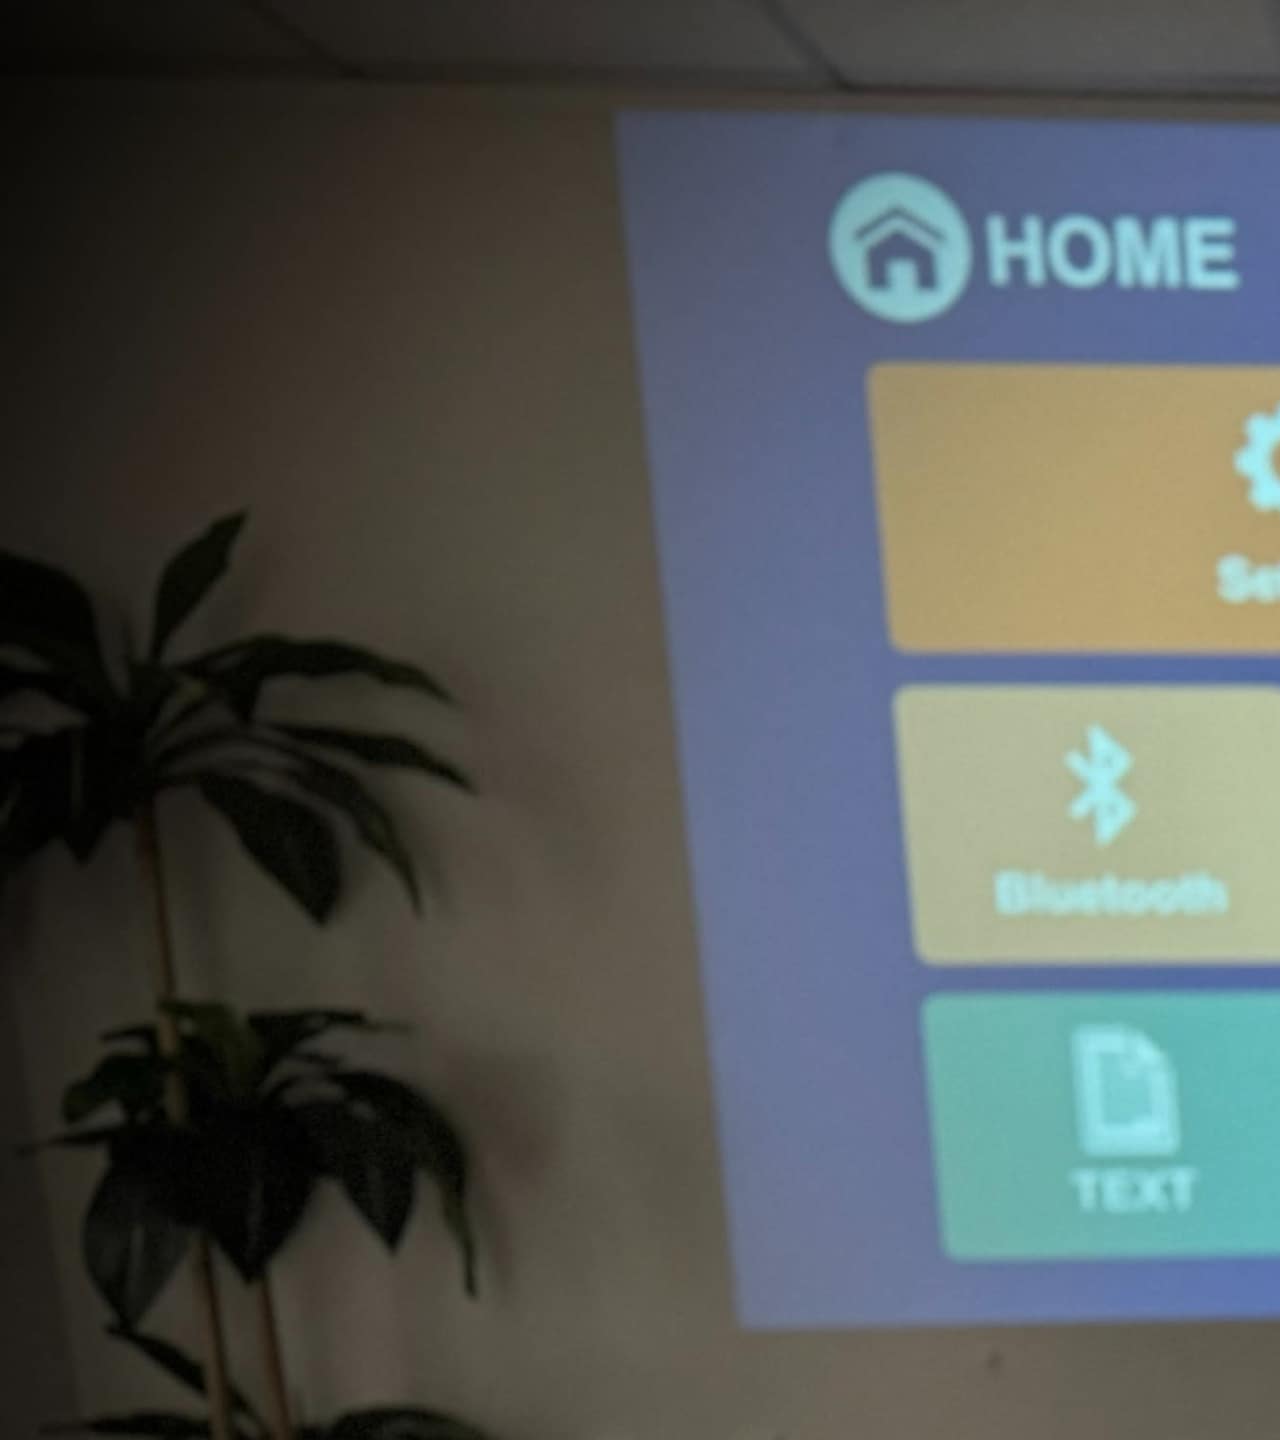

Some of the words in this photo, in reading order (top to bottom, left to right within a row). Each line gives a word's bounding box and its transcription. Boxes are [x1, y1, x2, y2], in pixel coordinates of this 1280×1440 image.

[986, 214, 1240, 290] HOME
[994, 869, 1228, 916] Bluetooth
[1069, 1166, 1196, 1213] TEXT
